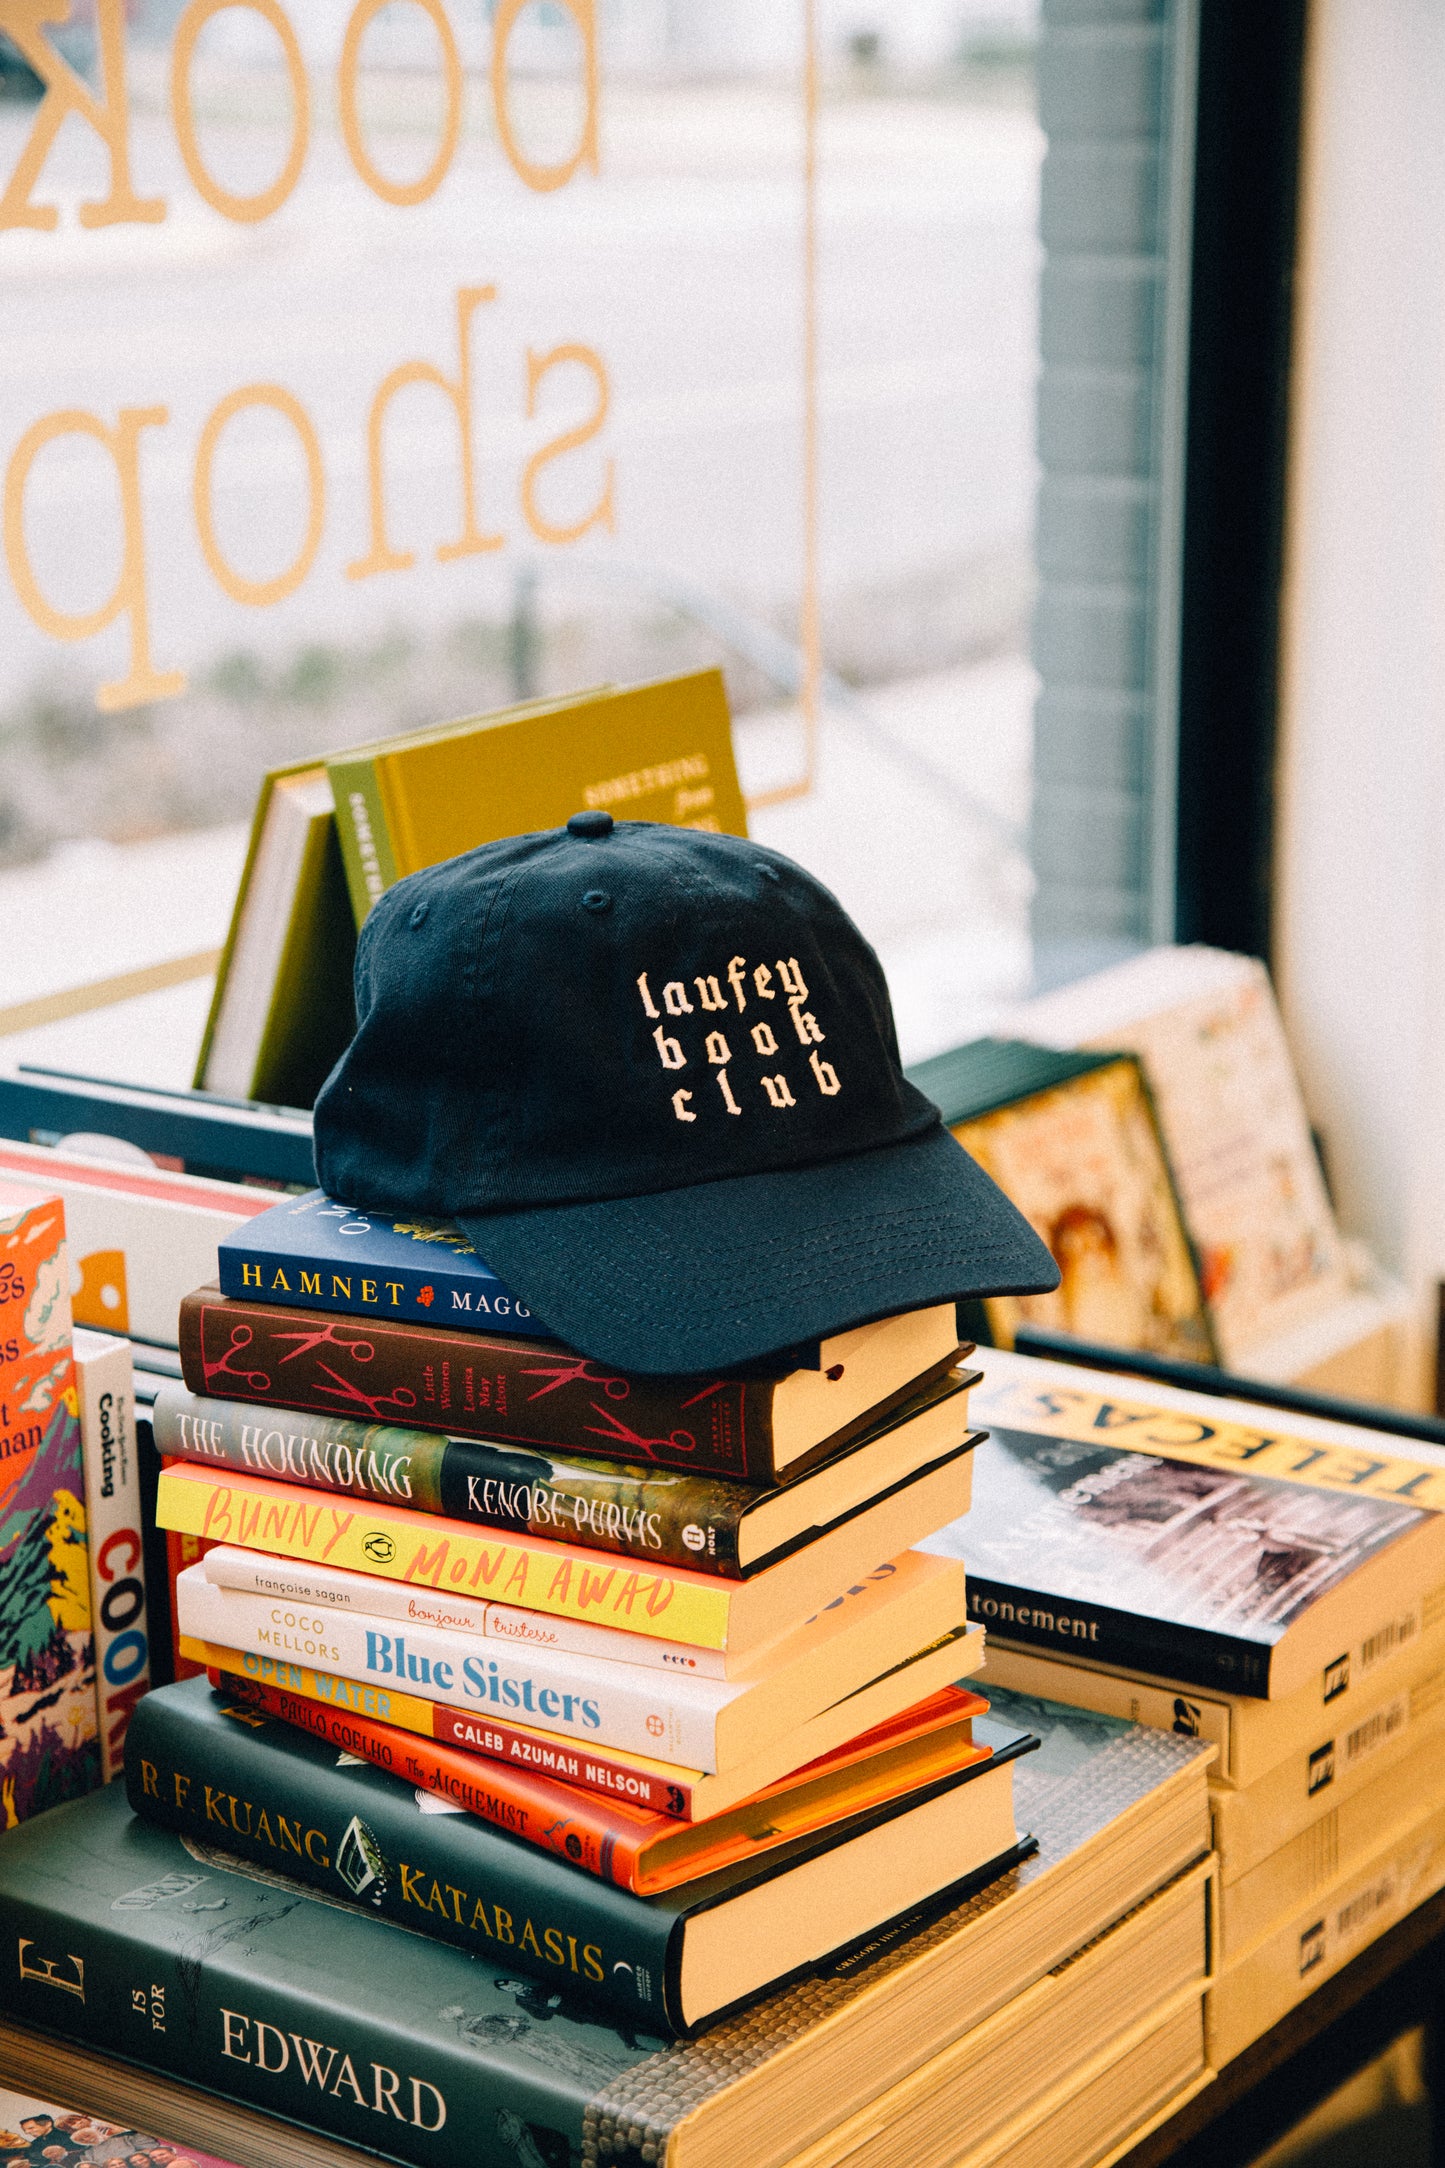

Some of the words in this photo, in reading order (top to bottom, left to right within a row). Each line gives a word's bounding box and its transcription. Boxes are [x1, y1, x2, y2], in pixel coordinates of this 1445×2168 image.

[636, 955, 809, 1019] laufey
[652, 1003, 826, 1070] book
[671, 1050, 842, 1122] club
[241, 1263, 405, 1306] HAMNET
[422, 1364, 435, 1401] Little
[440, 1361, 452, 1410] Women
[462, 1366, 476, 1413] Louisa
[479, 1377, 493, 1407] May
[495, 1374, 508, 1416] Alcott
[100, 1392, 116, 1498] Cooking
[176, 1413, 226, 1458] THE
[241, 1424, 413, 1499] HOUNDING
[203, 1486, 356, 1560] BUNNY
[466, 1475, 567, 1529] KENOBE
[574, 1496, 662, 1550] PURVIS
[708, 1526, 716, 1556] HOLT
[255, 1575, 312, 1596] françoise
[315, 1587, 351, 1603] sagan
[546, 1557, 675, 1618] AWAD
[258, 1628, 340, 1661] MELLORS
[271, 1609, 324, 1635] COCO
[408, 1599, 475, 1629] bonjour
[493, 1617, 559, 1644] tristesse
[966, 1594, 1100, 1643] tonement
[243, 1651, 303, 1690] OPEN
[313, 1672, 391, 1718] WATER
[365, 1630, 454, 1690] Blue
[463, 1656, 601, 1729] Sisters
[280, 1696, 327, 1735] PAULO
[331, 1721, 393, 1766] COELHO
[453, 1721, 504, 1751] CALEB
[510, 1740, 578, 1777] AZUMAH
[586, 1763, 650, 1800] NELSON
[405, 1756, 425, 1779] The
[204, 1785, 330, 1868] KUANG
[399, 1863, 605, 1983] KATABASIS
[19, 1938, 86, 2006] E
[132, 1988, 147, 2015] IS
[151, 1984, 166, 2033] FOR
[220, 2008, 447, 2132] EDWARD
